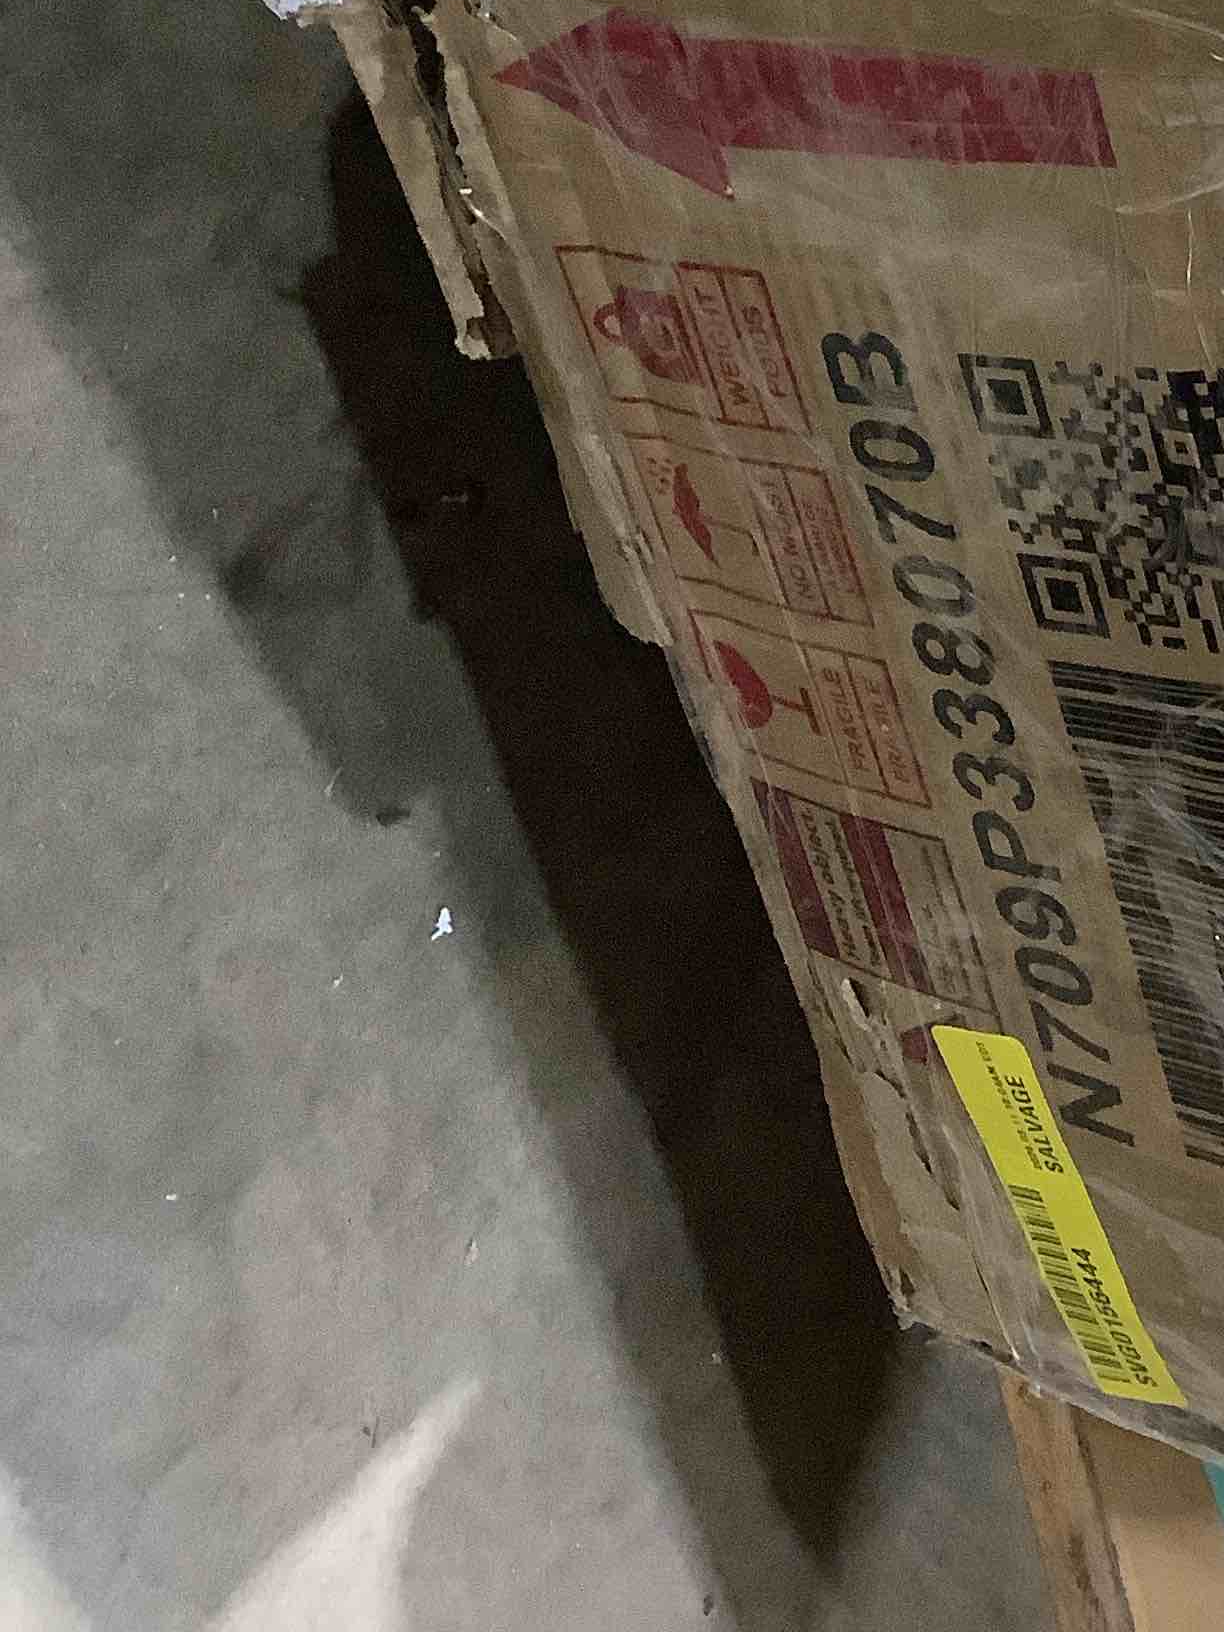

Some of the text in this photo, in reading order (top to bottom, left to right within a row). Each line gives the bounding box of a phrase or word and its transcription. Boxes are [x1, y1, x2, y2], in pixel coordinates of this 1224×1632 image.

[691, 286, 751, 406] WEIGHT
[818, 668, 873, 773] FRAGILE
[821, 331, 1134, 1147] N709P338070B
[1004, 1074, 1065, 1174] SALVAGE
[1070, 1247, 1158, 1388] SVG0156444
